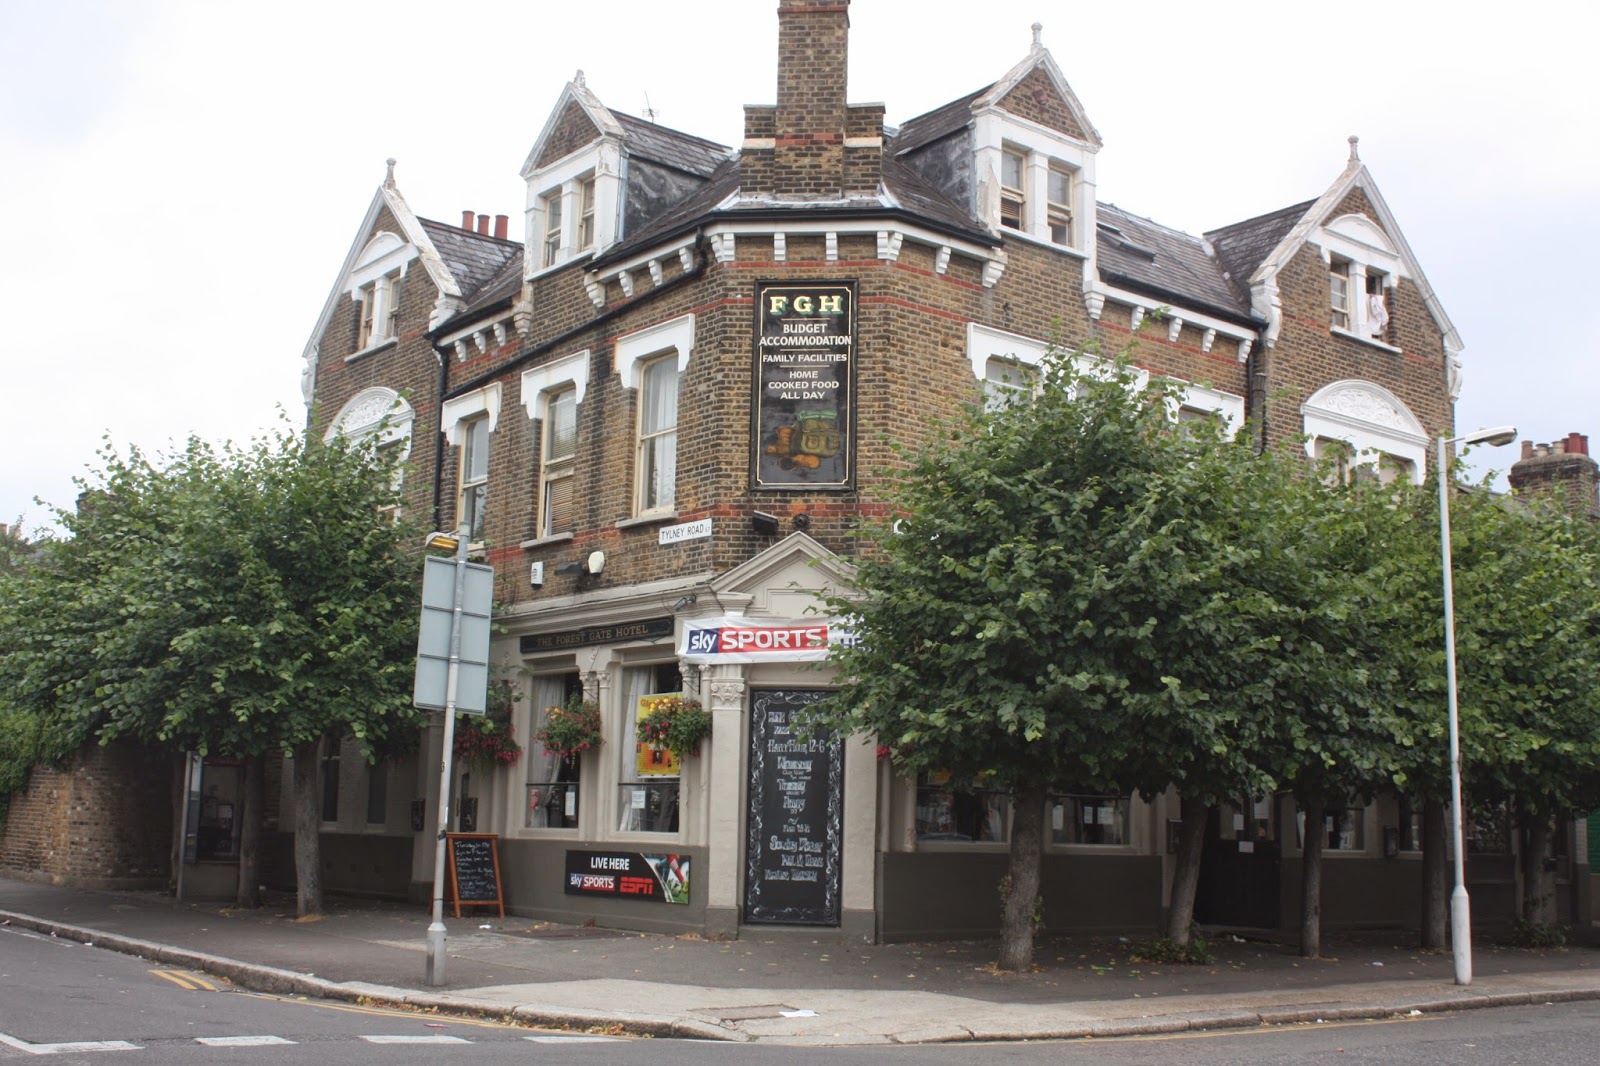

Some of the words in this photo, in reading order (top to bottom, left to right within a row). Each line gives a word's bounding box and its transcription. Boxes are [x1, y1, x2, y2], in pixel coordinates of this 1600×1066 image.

[769, 295, 844, 315] FGH
[783, 323, 828, 334] BUDGET
[759, 335, 852, 347] ACCOMMODATION
[762, 354, 795, 363] FAMILY
[798, 353, 848, 363] FACILITIES
[789, 370, 818, 379] HOME
[768, 381, 809, 390] COOKED
[811, 380, 840, 389] FOOD
[780, 391, 801, 400] ALL
[802, 391, 826, 399] DAY
[661, 527, 685, 540] TYLNEY
[687, 523, 704, 536] ROAD
[537, 637, 553, 647] THE
[556, 632, 585, 645] FOREST
[589, 629, 612, 641] GATE
[615, 624, 649, 637] HOTEL
[690, 630, 717, 653] sky
[721, 628, 822, 650] SPORTS
[590, 856, 608, 870] LIVE
[608, 857, 630, 871] HERE
[570, 874, 583, 888] sky
[583, 876, 615, 889] SPORTS
[620, 876, 653, 895] ESPN
